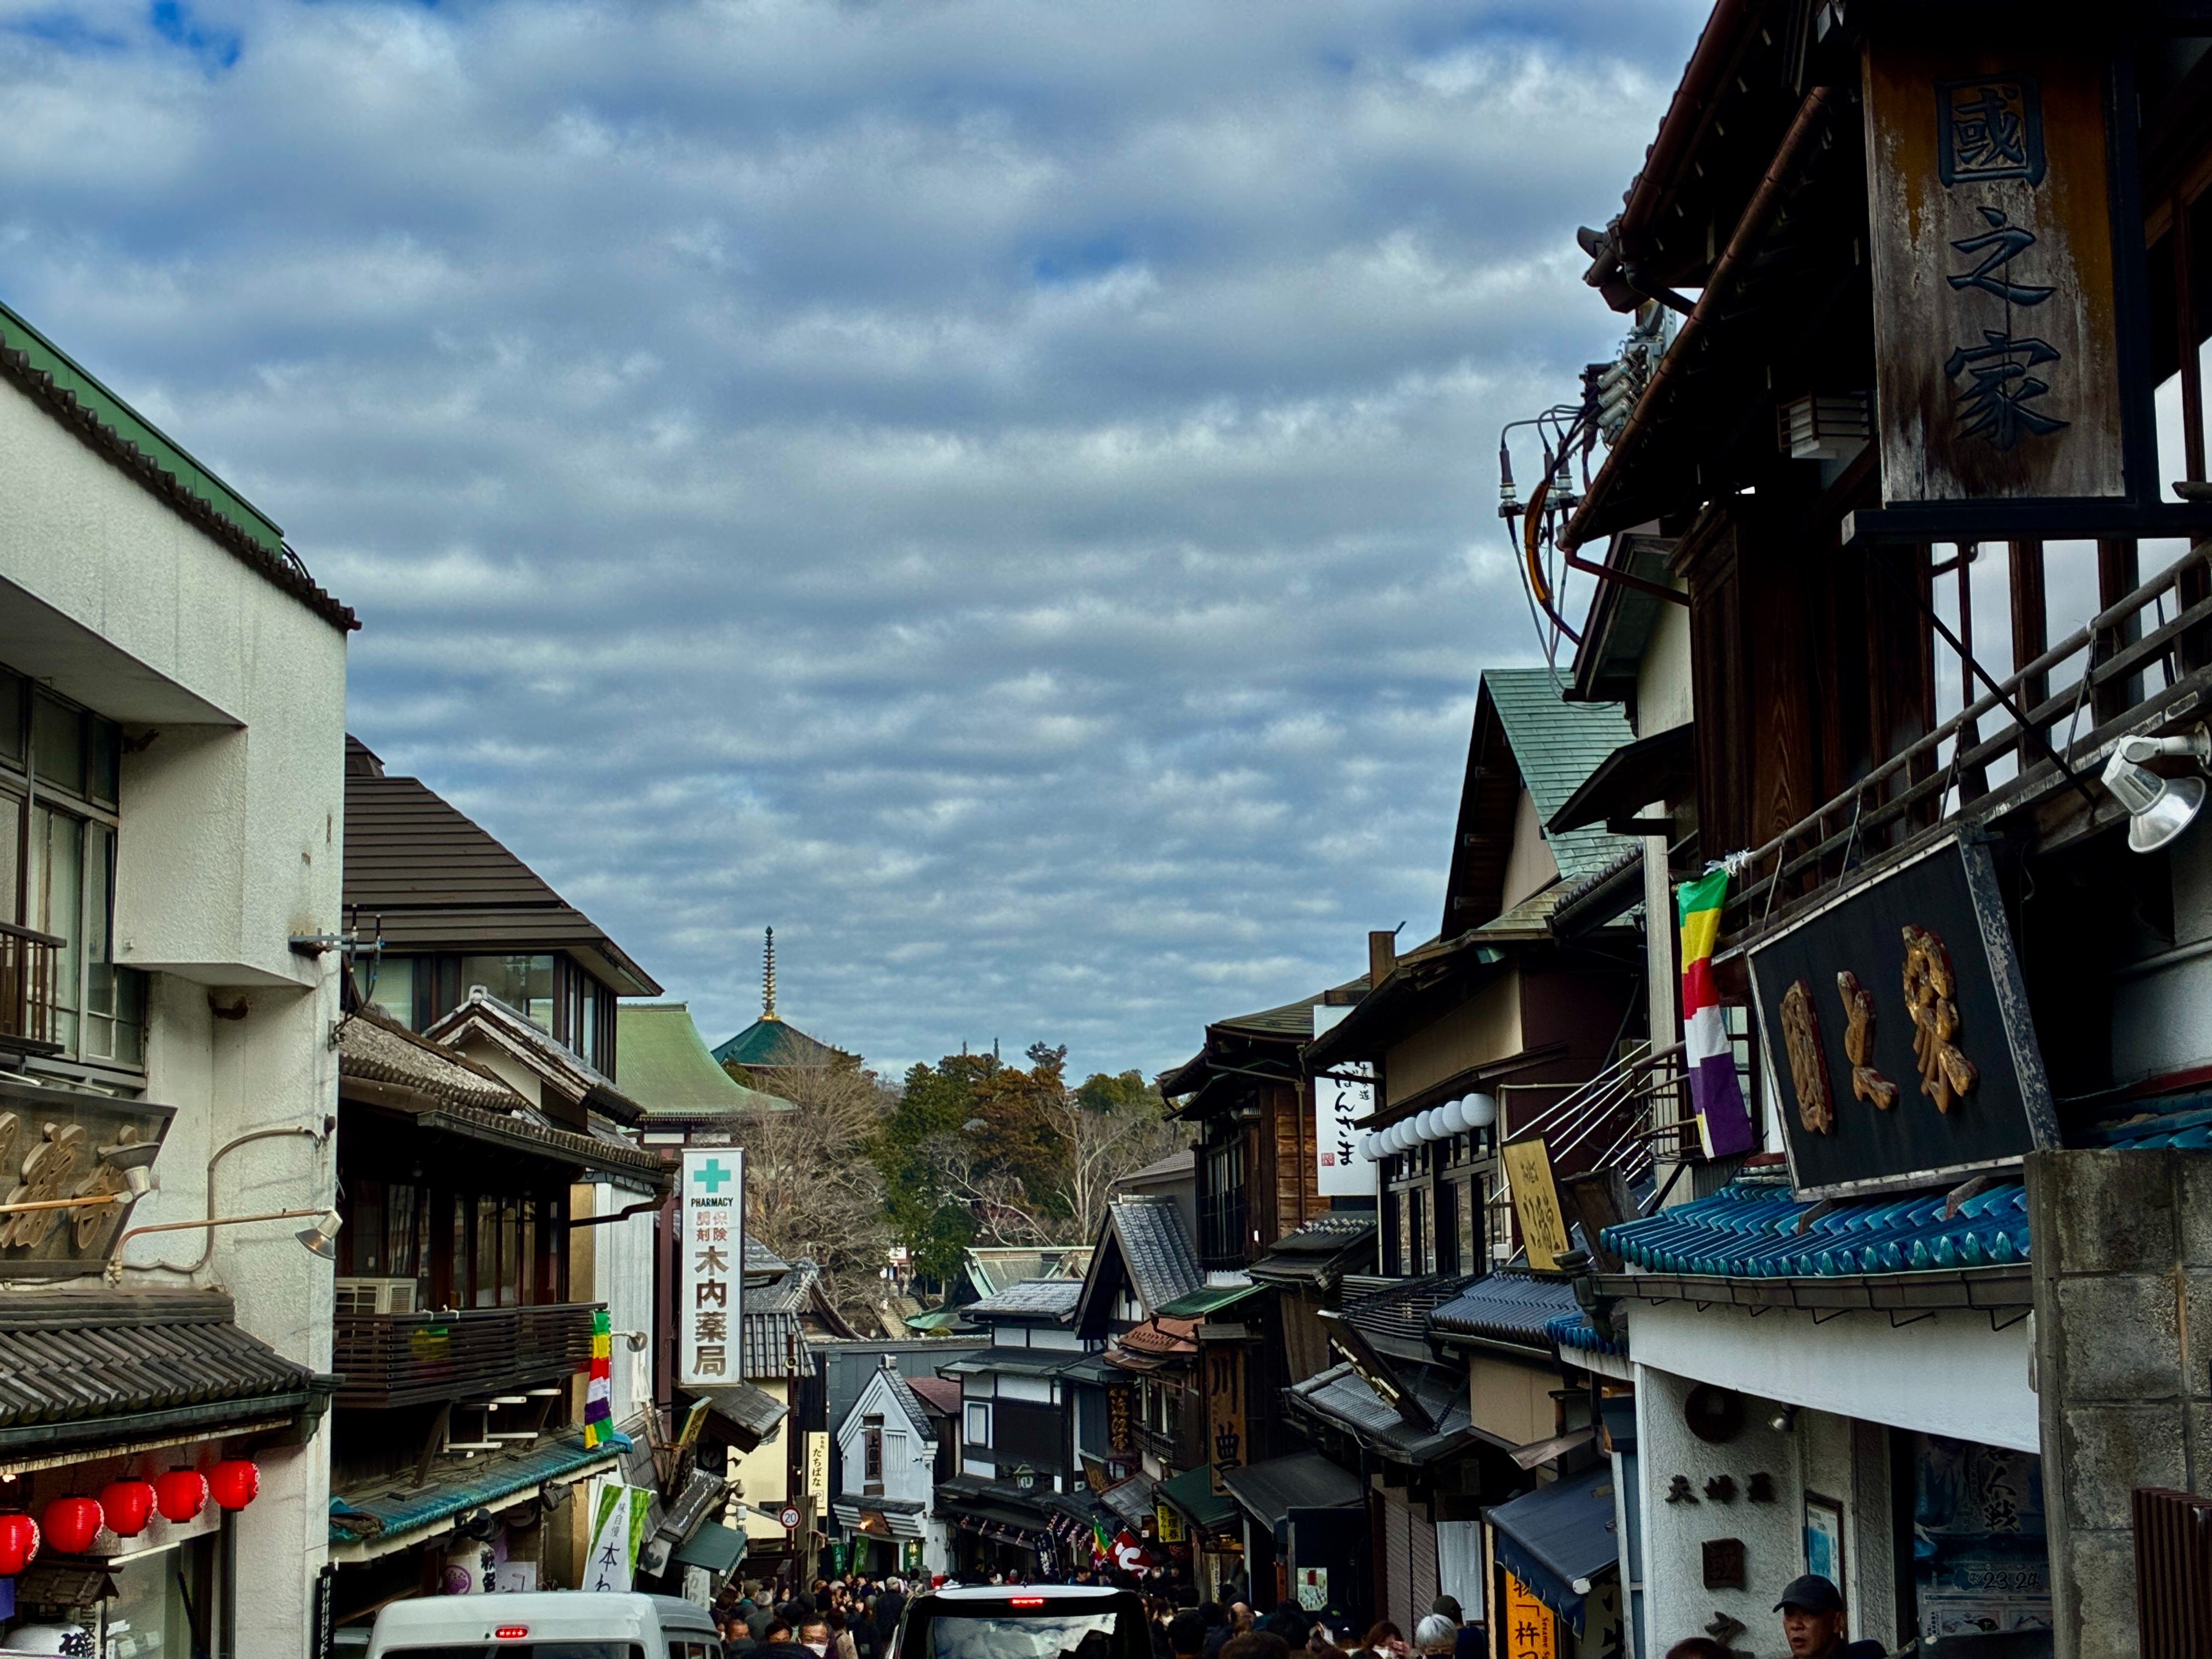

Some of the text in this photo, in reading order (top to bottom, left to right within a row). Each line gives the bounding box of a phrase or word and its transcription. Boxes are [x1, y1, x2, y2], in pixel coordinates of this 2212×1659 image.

[1936, 72, 2072, 452] 國之家
[691, 1197, 734, 1207] PHARMACY
[713, 1211, 728, 1242] 保険
[692, 1245, 729, 1376] 木内薬局
[812, 1448, 822, 1487] たちばな
[611, 1502, 627, 1538] 味自慢
[784, 1513, 797, 1523] 20
